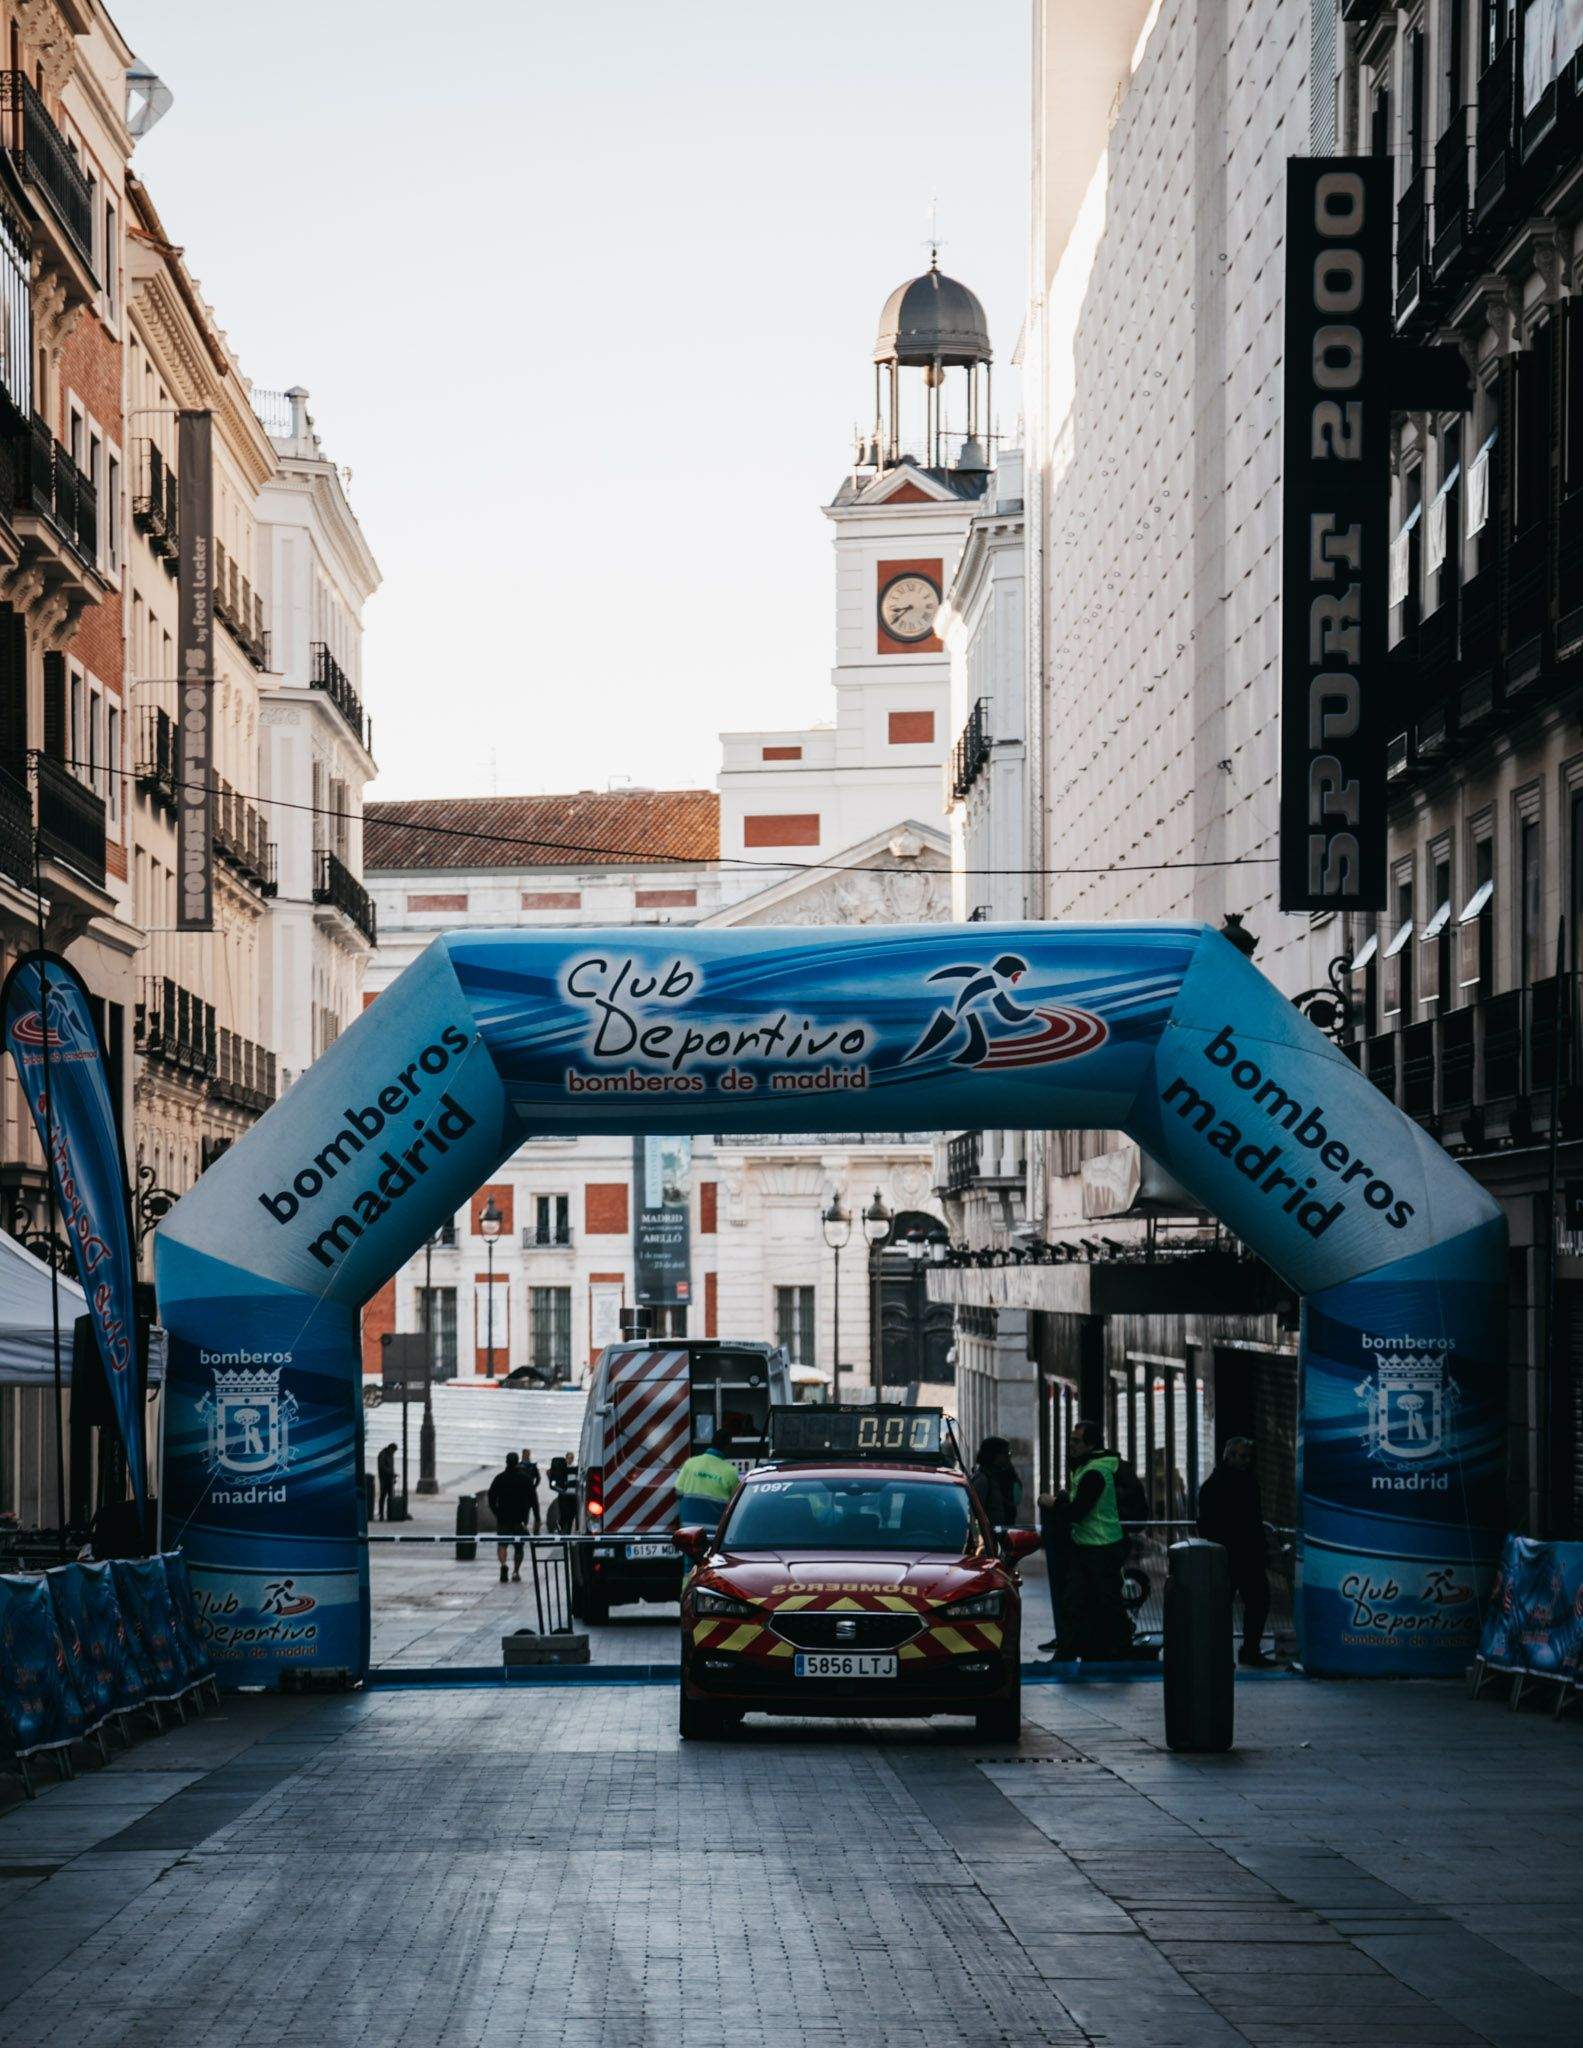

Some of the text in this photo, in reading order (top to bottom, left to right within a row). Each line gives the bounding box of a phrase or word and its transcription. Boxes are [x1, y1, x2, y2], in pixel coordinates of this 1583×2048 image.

[1308, 171, 1367, 898] SPORT 2000
[192, 535, 206, 591] Locker
[191, 592, 206, 627] Foot
[197, 627, 208, 643] by
[184, 808, 206, 921] HOUSE
[566, 958, 695, 1004] Club
[594, 998, 866, 1070] Deportivo
[568, 1066, 867, 1092] bomberos de madrid
[258, 1025, 469, 1225] bomberos
[1203, 1024, 1415, 1229] bomberos
[1161, 1077, 1346, 1239] madrid
[307, 1092, 477, 1268] madrid
[641, 1214, 683, 1223] MADRID
[1361, 1332, 1456, 1350] bomberos
[199, 1348, 293, 1365] bomberos
[211, 1485, 287, 1504] madrid
[753, 1481, 794, 1493] 1097
[1370, 1472, 1449, 1490] madrid
[633, 1545, 657, 1556] 6157
[1342, 1576, 1398, 1601] Club
[1352, 1599, 1475, 1635] Deportivo
[807, 1657, 893, 1675] 5856 LTJ
